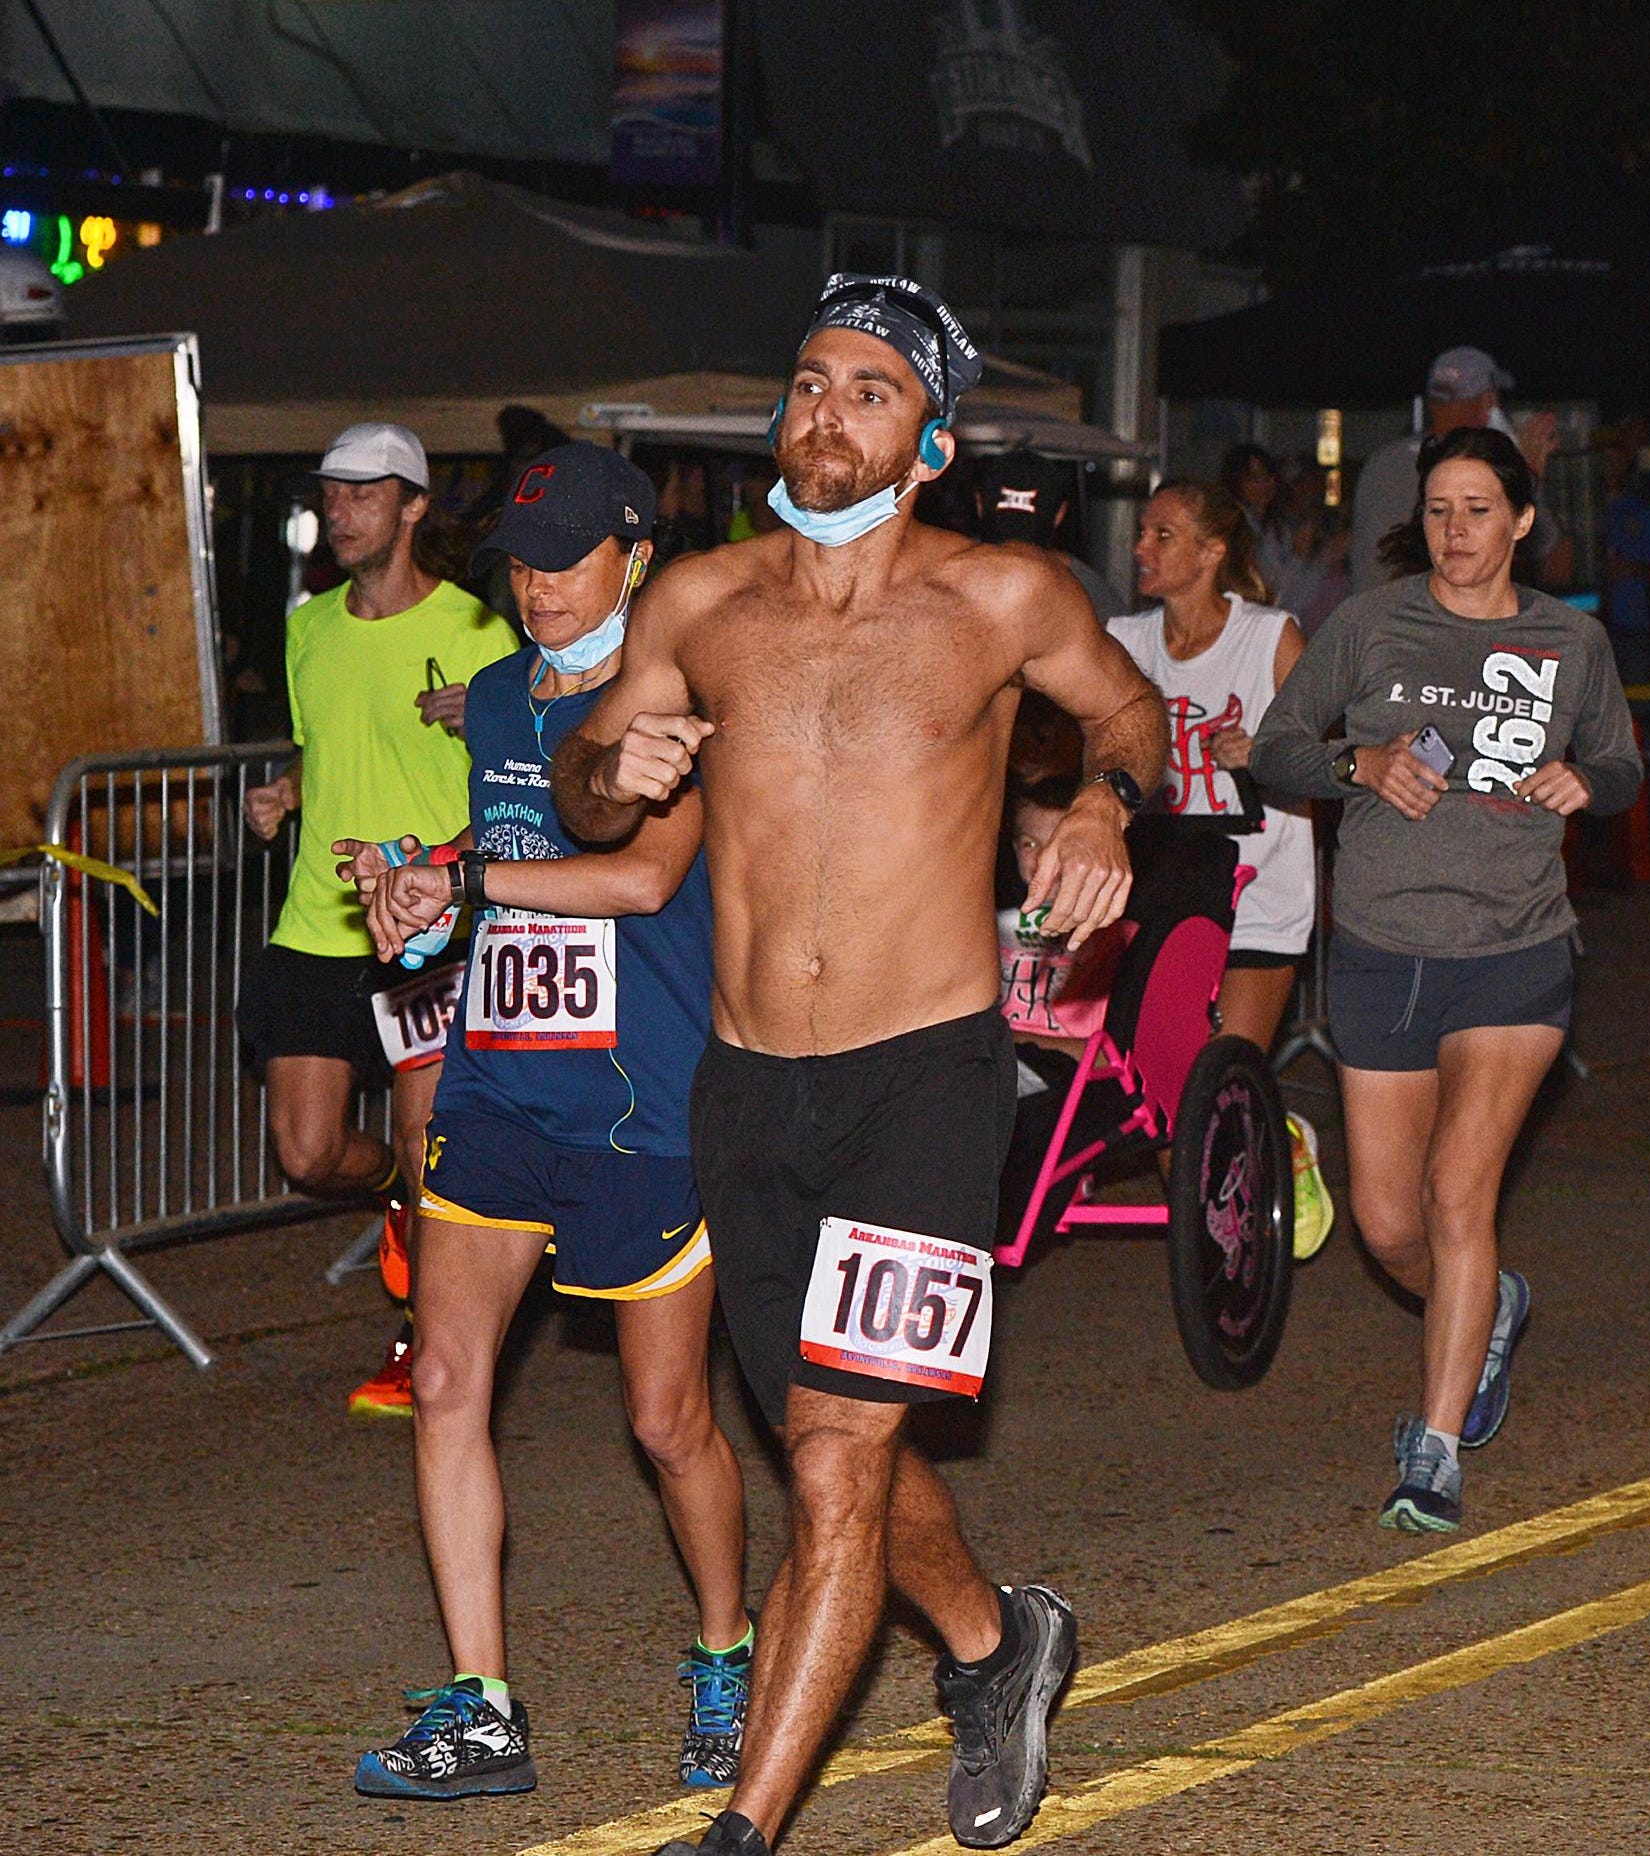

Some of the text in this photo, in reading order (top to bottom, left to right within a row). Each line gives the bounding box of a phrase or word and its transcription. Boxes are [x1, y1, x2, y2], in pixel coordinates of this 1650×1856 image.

[936, 304, 979, 361] OUTLAW
[1419, 685, 1532, 717] ST. JUDE
[483, 770, 517, 785] Rock
[504, 759, 542, 773] Humana
[484, 801, 544, 828] MARATHON
[481, 944, 598, 1020] 1035
[833, 1252, 983, 1358] 1057
